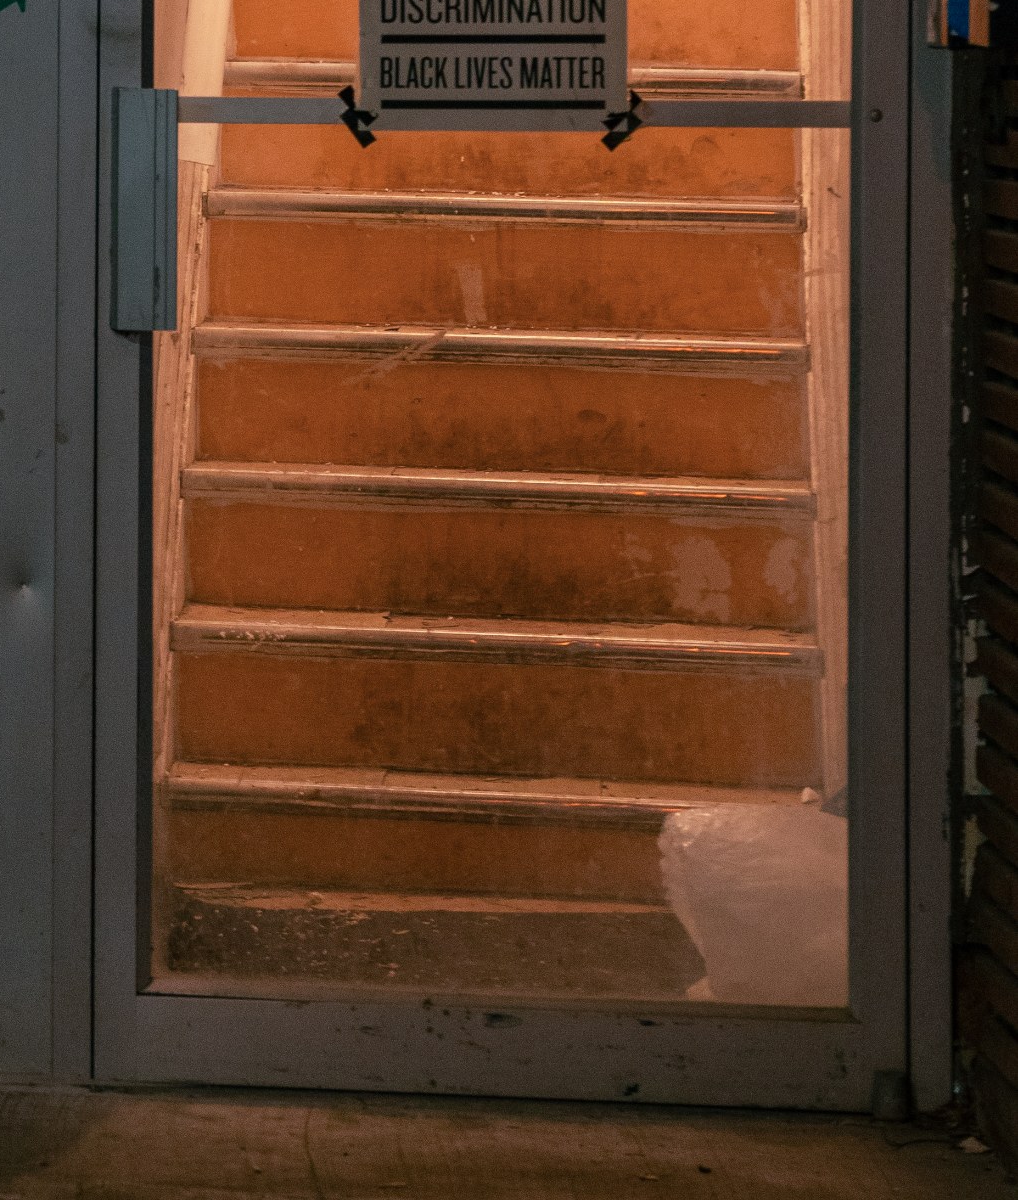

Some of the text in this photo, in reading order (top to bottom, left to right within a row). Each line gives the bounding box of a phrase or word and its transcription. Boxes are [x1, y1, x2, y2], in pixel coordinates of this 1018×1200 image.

[382, 56, 606, 89] BLACK LIVES MATTER
